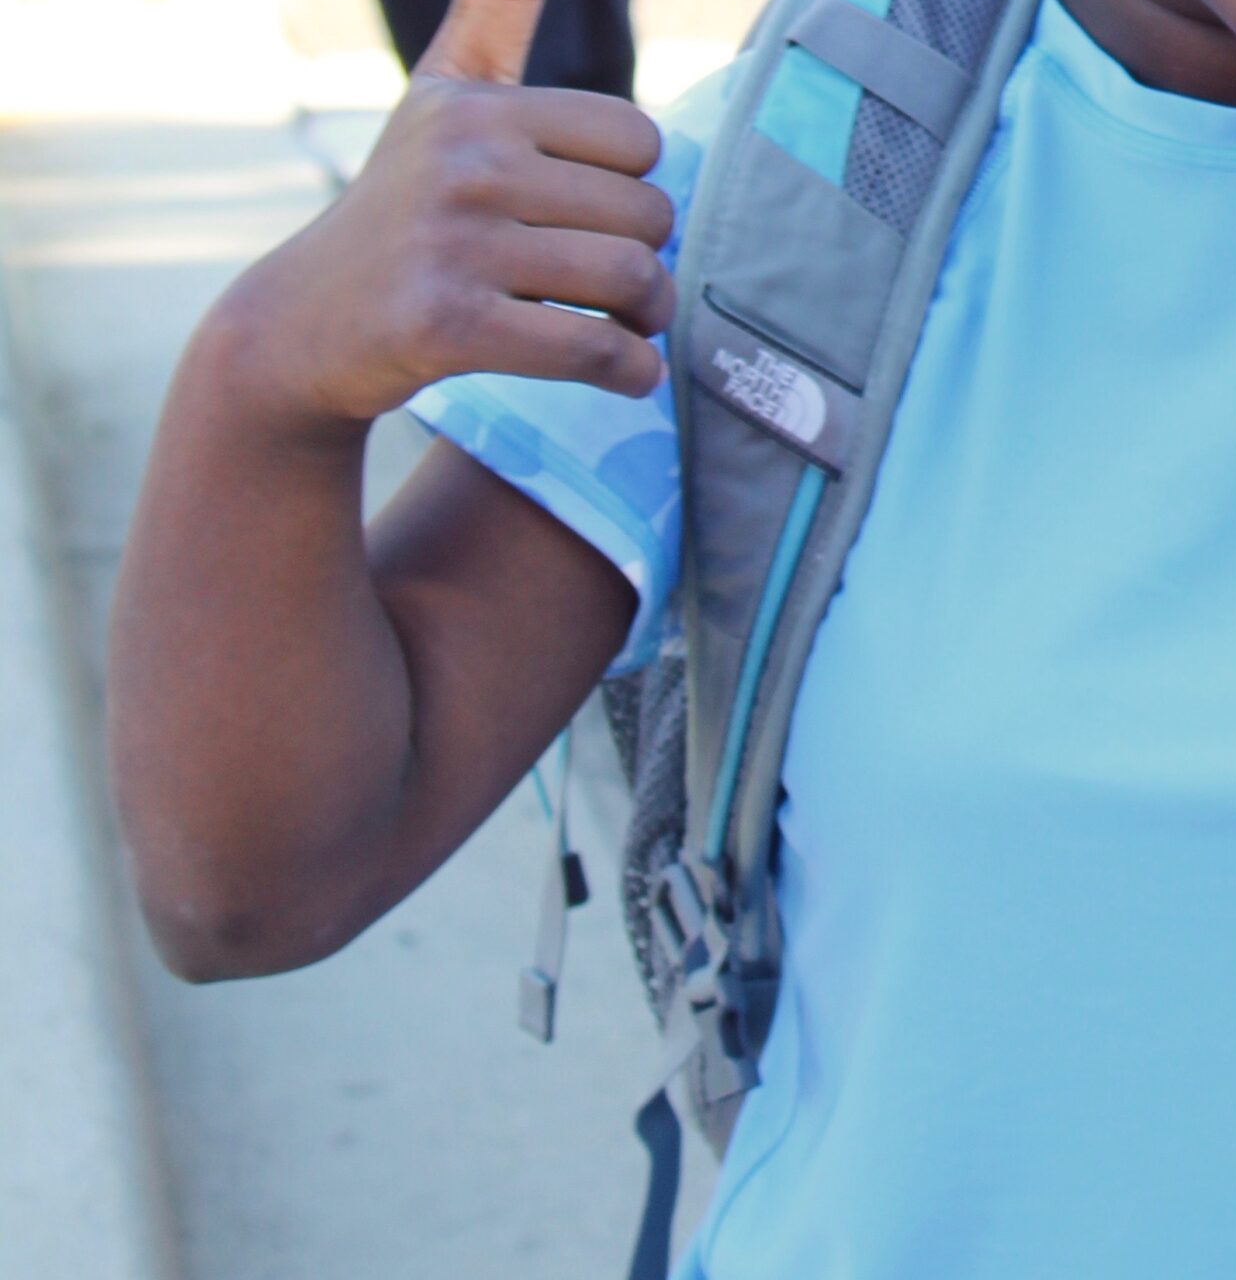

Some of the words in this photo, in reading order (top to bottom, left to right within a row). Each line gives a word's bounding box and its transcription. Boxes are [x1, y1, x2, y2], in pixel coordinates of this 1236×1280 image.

[710, 347, 788, 403] NORTH
[754, 347, 799, 387] THE
[721, 376, 779, 421] FACE
